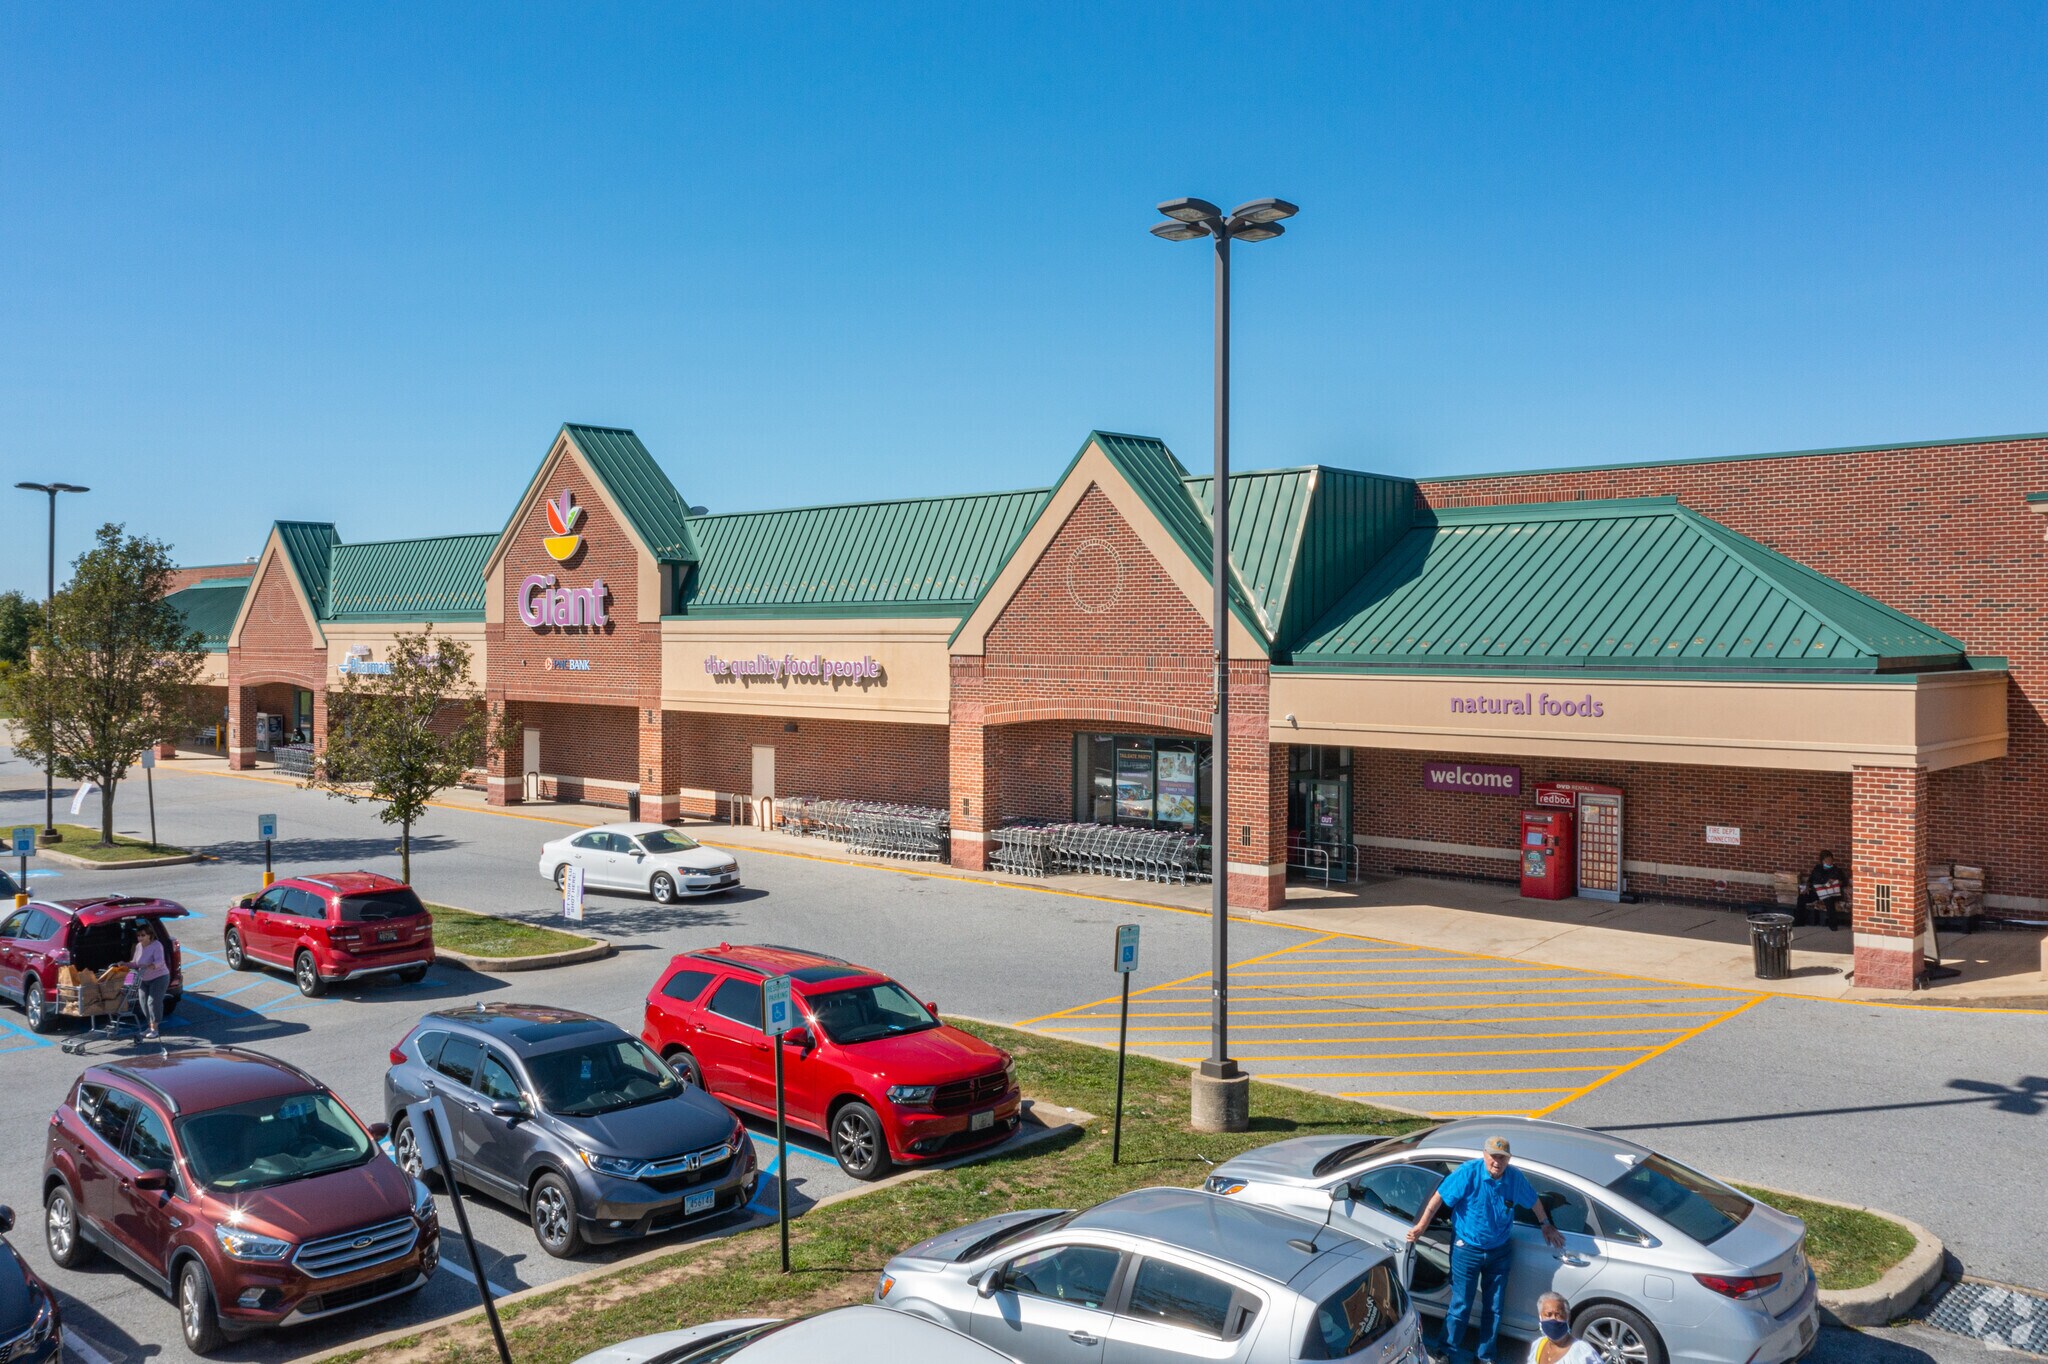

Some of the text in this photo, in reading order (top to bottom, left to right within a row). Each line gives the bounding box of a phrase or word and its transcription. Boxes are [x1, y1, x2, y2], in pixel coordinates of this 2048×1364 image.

[518, 574, 608, 627] Giant
[569, 659, 590, 670] BANK
[704, 653, 881, 683] the quality food people
[1450, 692, 1604, 717] natural foods
[1430, 766, 1514, 788] welcome
[1539, 794, 1571, 805] redbox
[1708, 835, 1739, 843] CONNECTION
